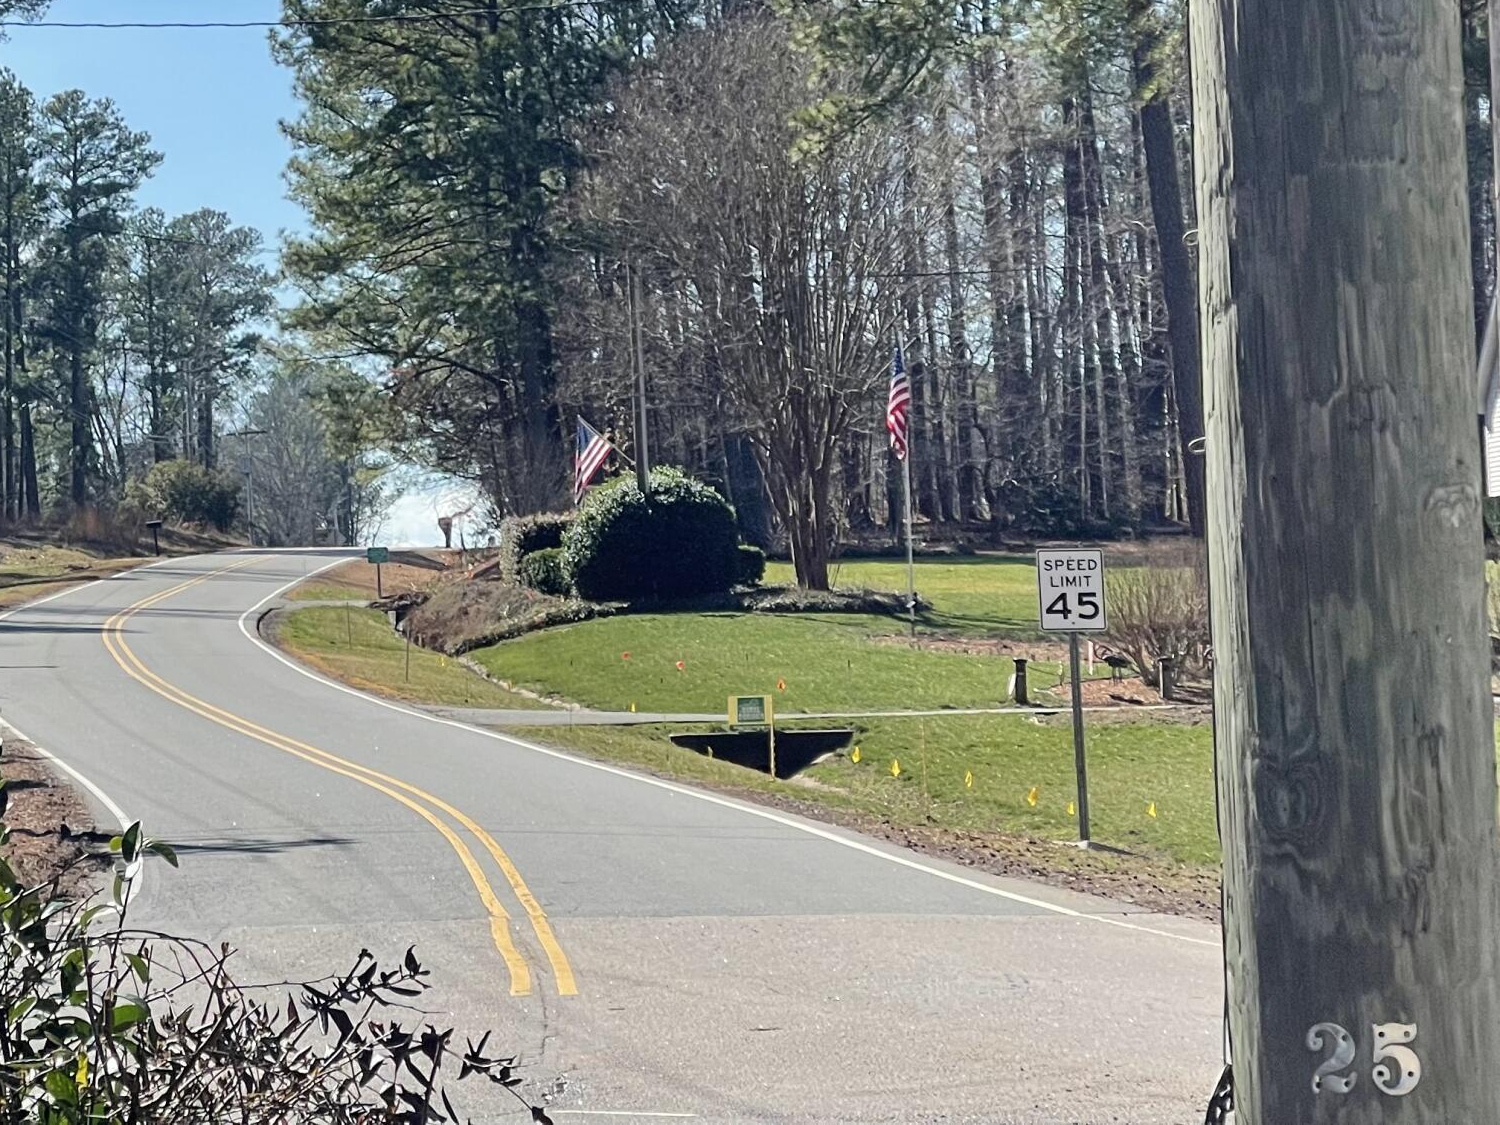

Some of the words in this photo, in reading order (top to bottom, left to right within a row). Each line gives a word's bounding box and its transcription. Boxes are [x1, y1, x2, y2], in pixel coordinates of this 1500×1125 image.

[1043, 559, 1098, 571] SPEED
[1050, 575, 1092, 587] LIMIT
[1045, 592, 1100, 620] 45
[1305, 1022, 1421, 1096] 25
